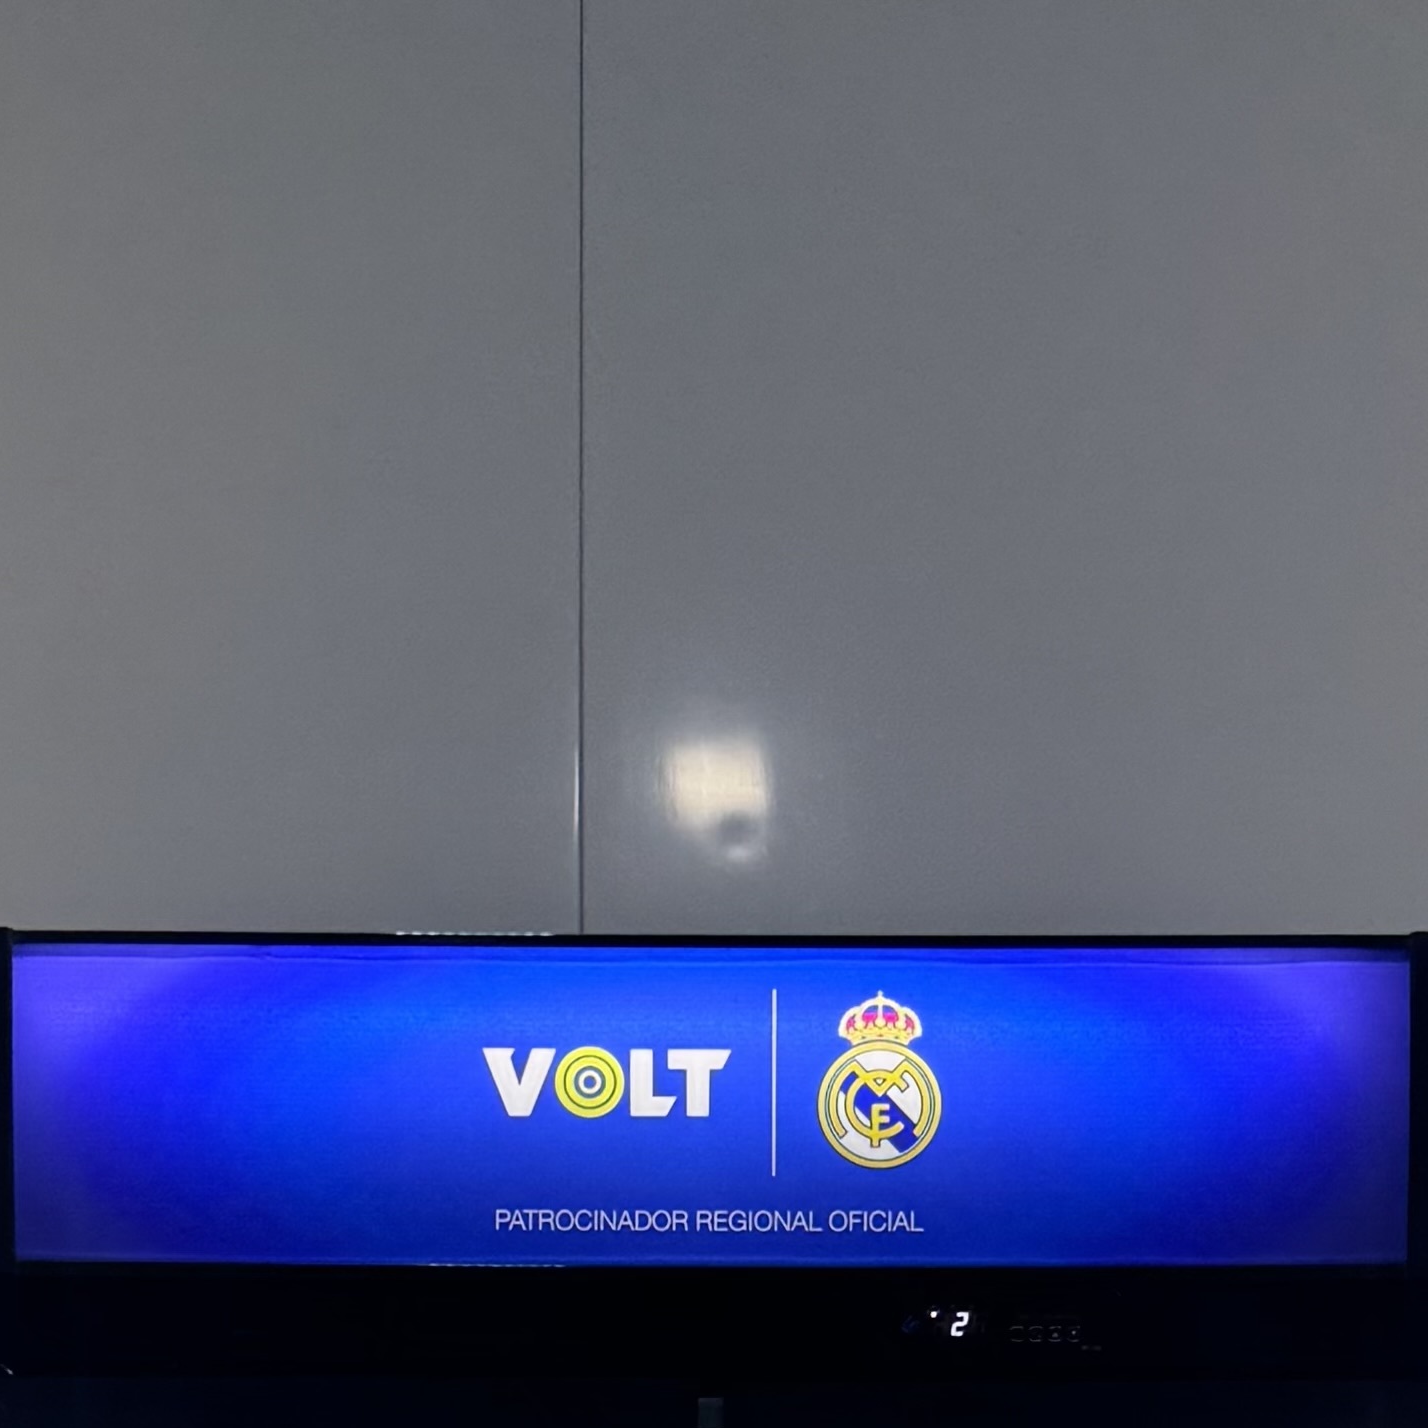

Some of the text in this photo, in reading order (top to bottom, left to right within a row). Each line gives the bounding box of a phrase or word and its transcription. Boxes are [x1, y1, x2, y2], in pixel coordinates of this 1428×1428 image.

[481, 1045, 732, 1118] VOLT
[495, 1209, 924, 1233] PATROCINADOR REGIONAL OFICIAL
